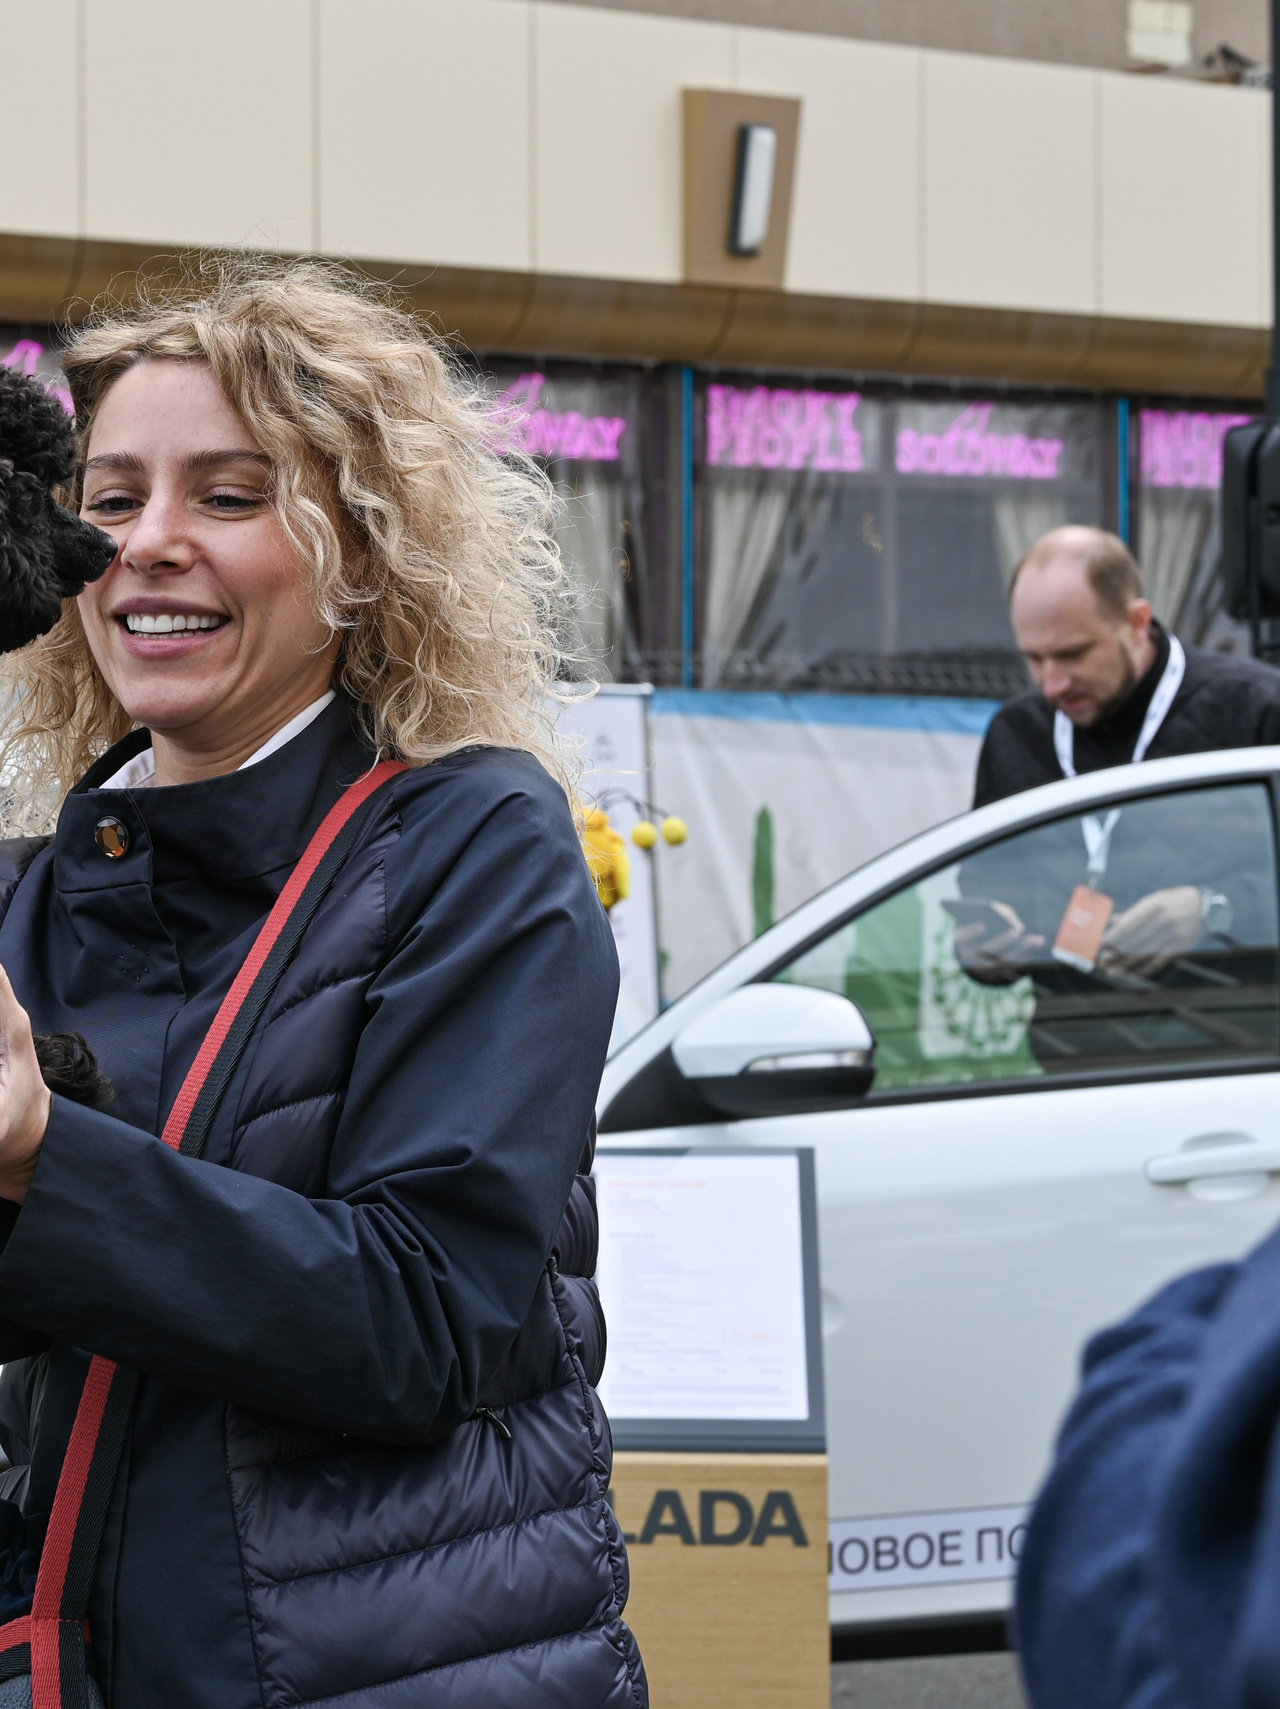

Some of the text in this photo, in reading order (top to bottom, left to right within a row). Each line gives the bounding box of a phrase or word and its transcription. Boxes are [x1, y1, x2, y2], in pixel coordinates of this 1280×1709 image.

[707, 385, 862, 429] SMOKY
[706, 422, 864, 472] PEOPLE
[827, 1529, 963, 1575] ОВОЕ
